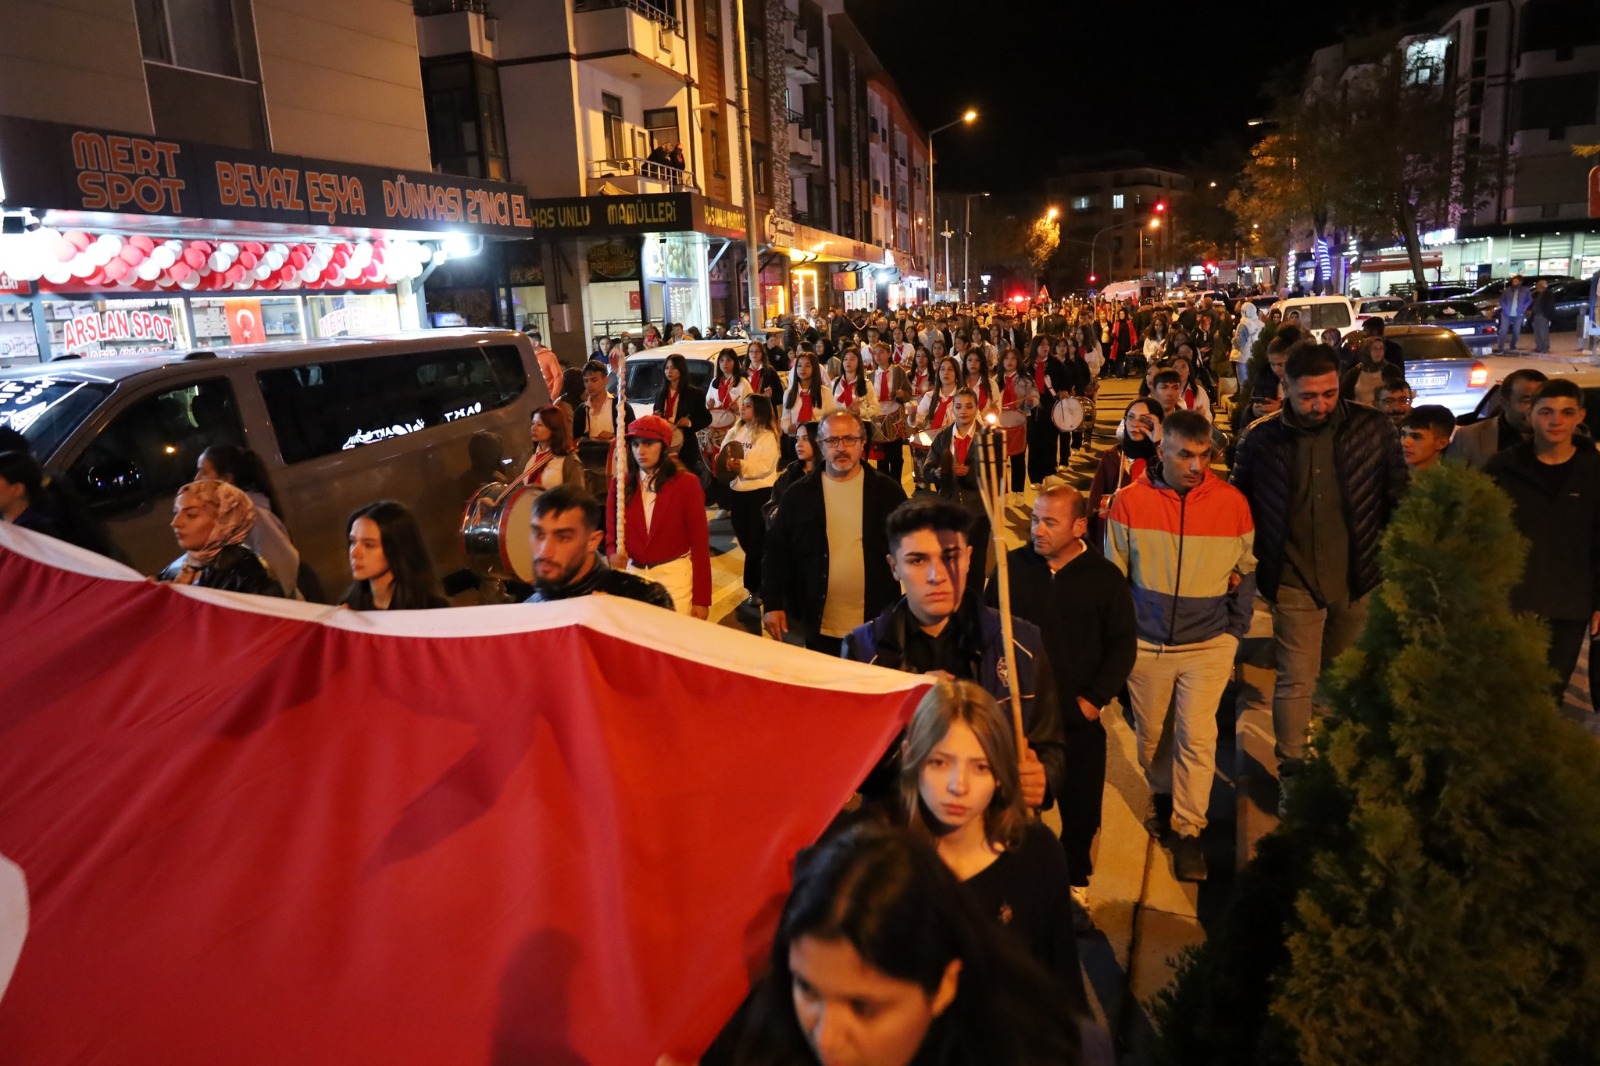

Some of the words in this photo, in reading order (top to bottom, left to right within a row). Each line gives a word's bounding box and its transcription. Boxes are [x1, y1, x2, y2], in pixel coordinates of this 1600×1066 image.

[72, 131, 180, 177] MERT
[77, 171, 185, 213] SPOT
[215, 161, 304, 210] BEYAZ
[305, 171, 366, 224] EŞYA
[382, 174, 464, 223] DÜNYASI
[511, 194, 531, 227] EL
[531, 207, 555, 228] HAS
[558, 205, 590, 227] UNLU
[64, 310, 129, 351] ARSLAN
[131, 310, 174, 344] SPOT
